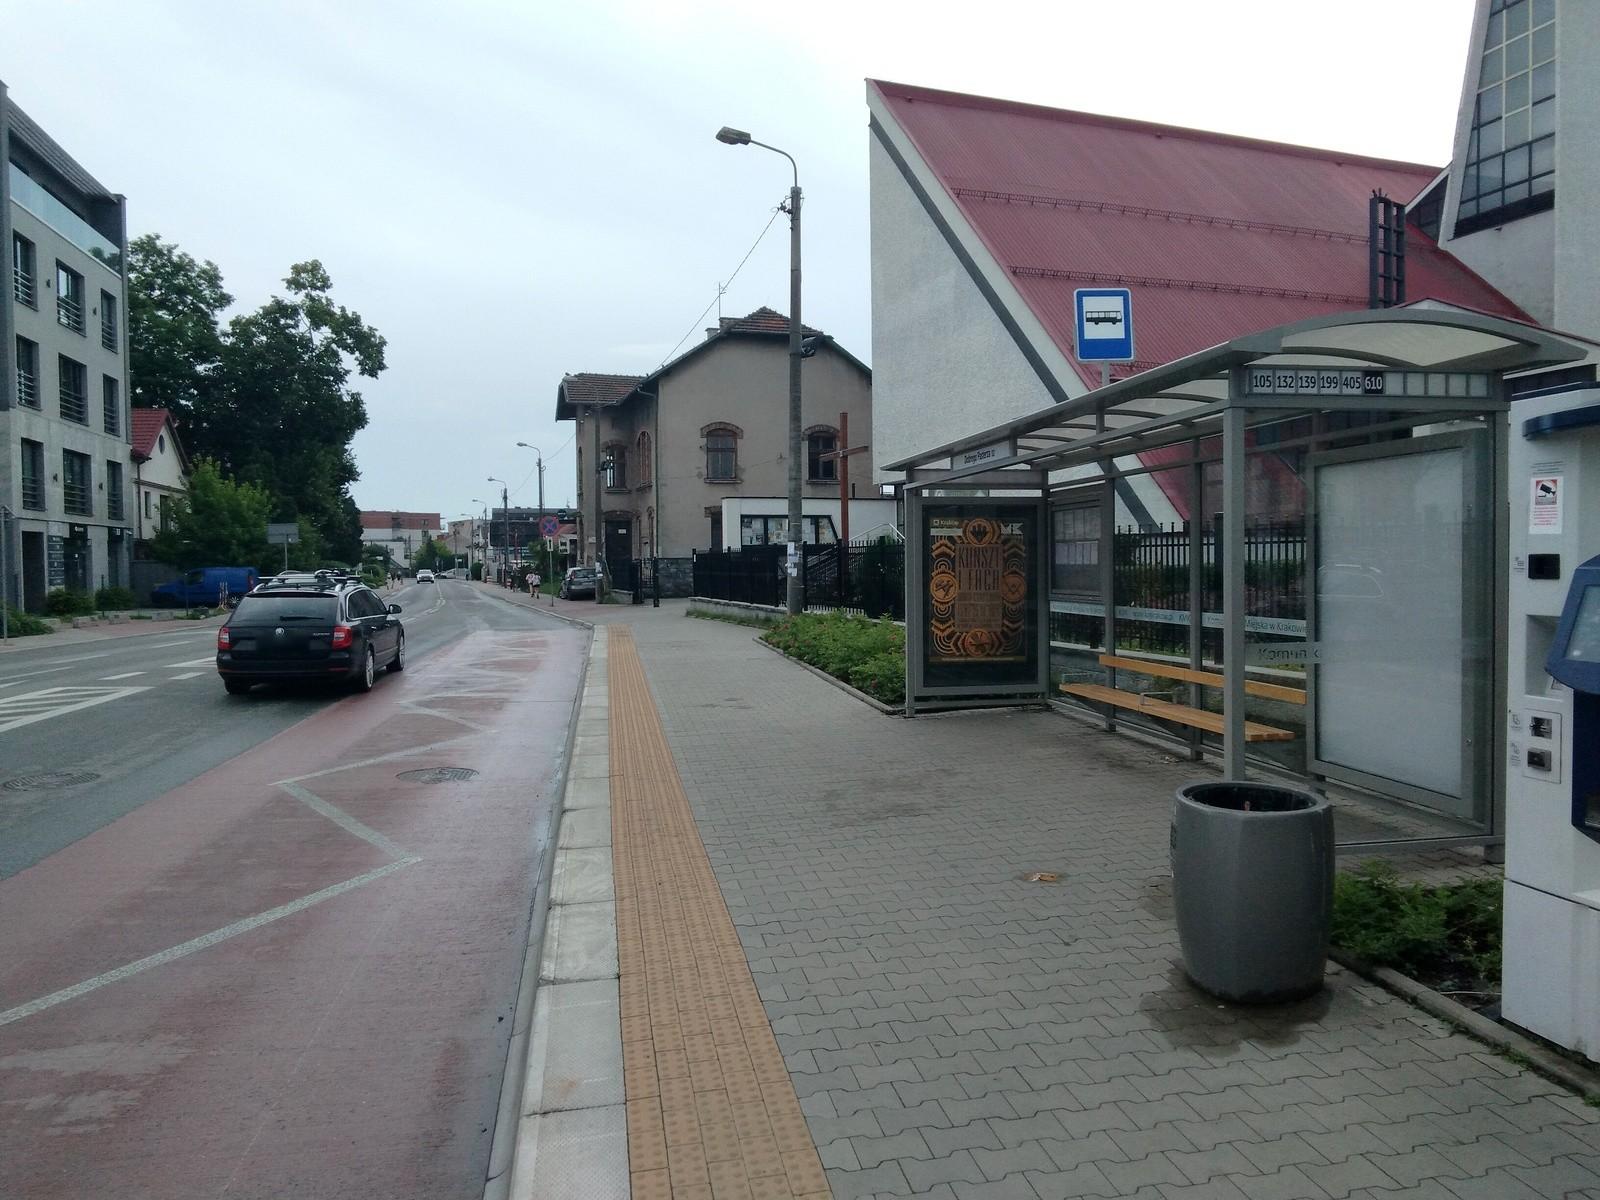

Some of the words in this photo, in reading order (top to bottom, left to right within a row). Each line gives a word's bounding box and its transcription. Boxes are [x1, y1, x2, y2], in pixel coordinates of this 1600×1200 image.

[1254, 375, 1271, 387] 105
[1277, 375, 1294, 388] 132
[1299, 376, 1316, 388] 139
[1321, 376, 1338, 388] 199
[1343, 376, 1361, 389] 405
[1365, 376, 1383, 390] 610
[1276, 621, 1305, 632] Krakowi
